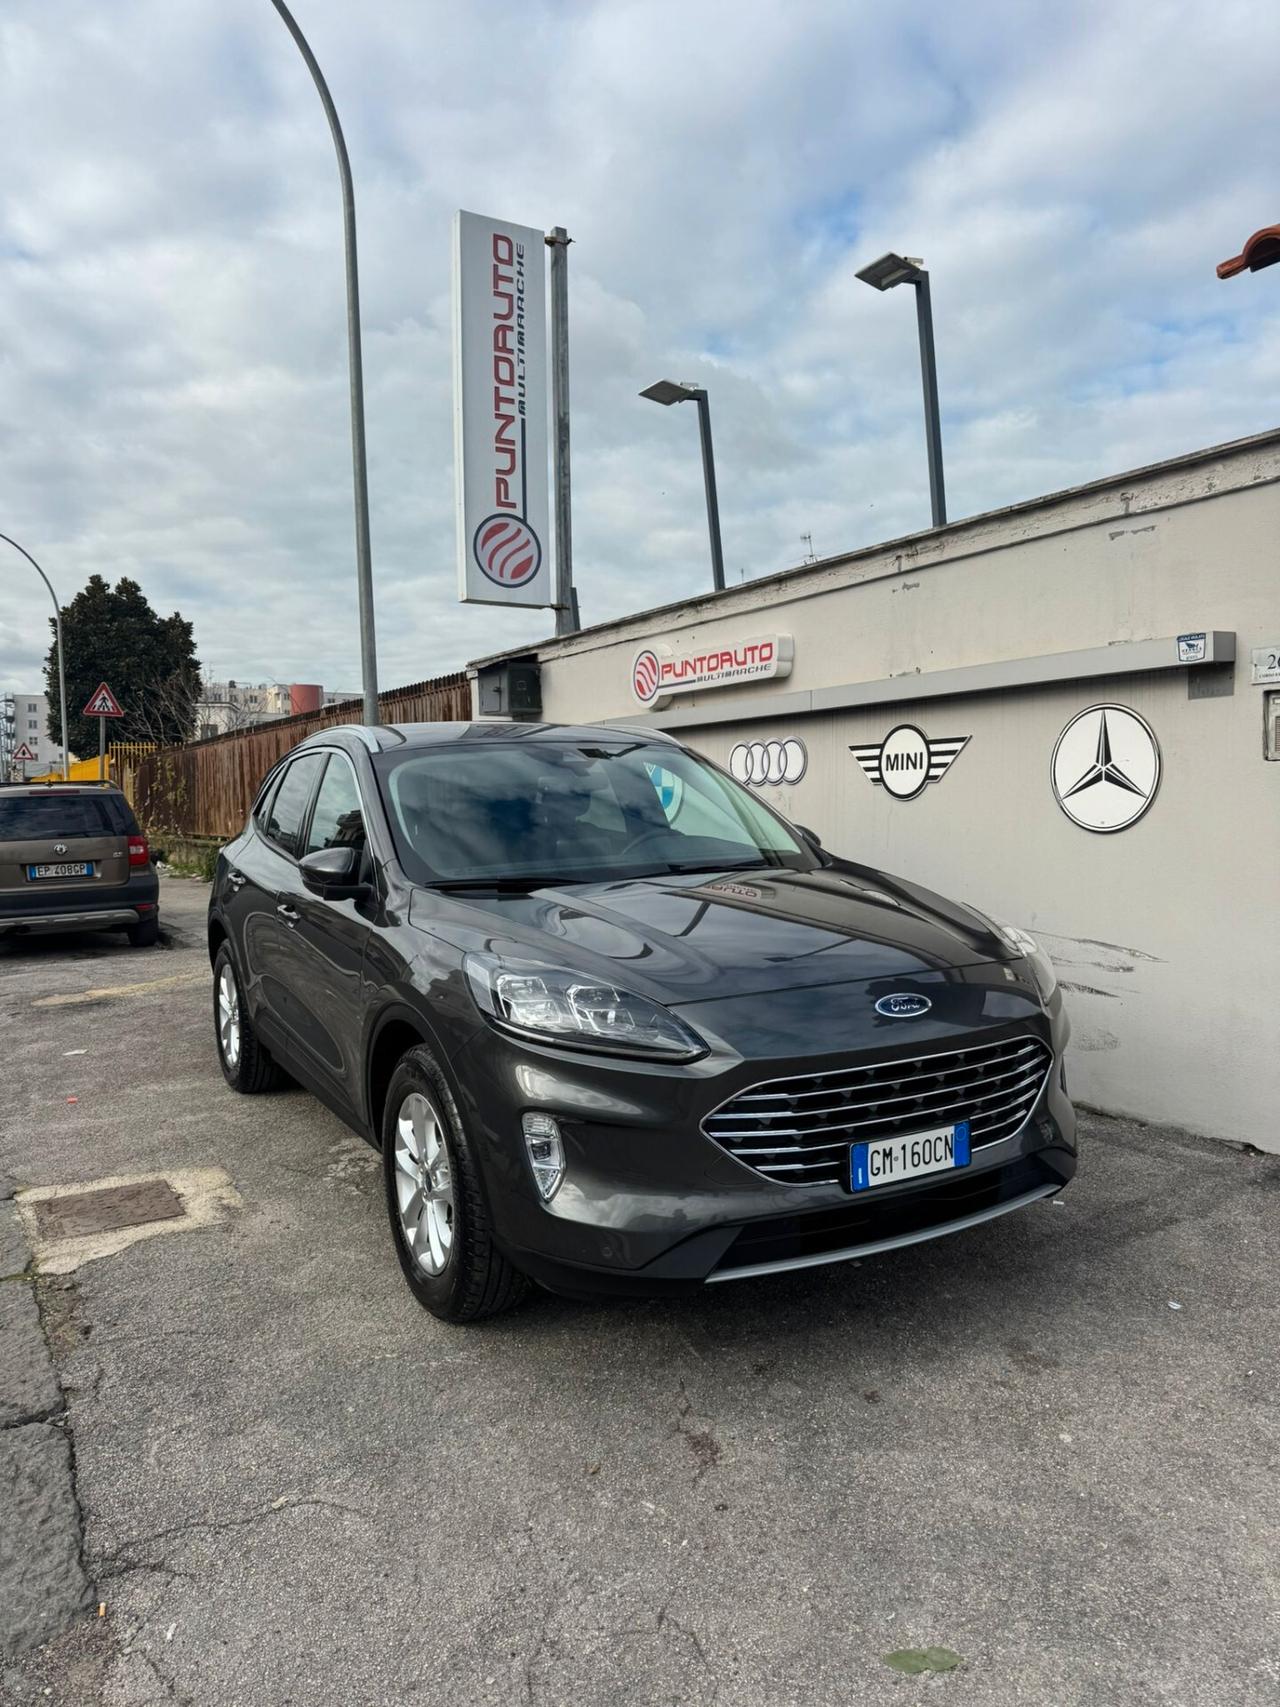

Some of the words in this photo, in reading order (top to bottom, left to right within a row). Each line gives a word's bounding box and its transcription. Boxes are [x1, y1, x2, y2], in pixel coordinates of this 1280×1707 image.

[516, 242, 527, 417] MULTIMARCHE
[493, 233, 517, 509] PUNTOAUTO
[660, 642, 774, 681] PUNTOAUTO
[696, 662, 772, 682] MULTIMARCHE
[885, 751, 923, 771] MINI
[890, 996, 921, 1012] Ford
